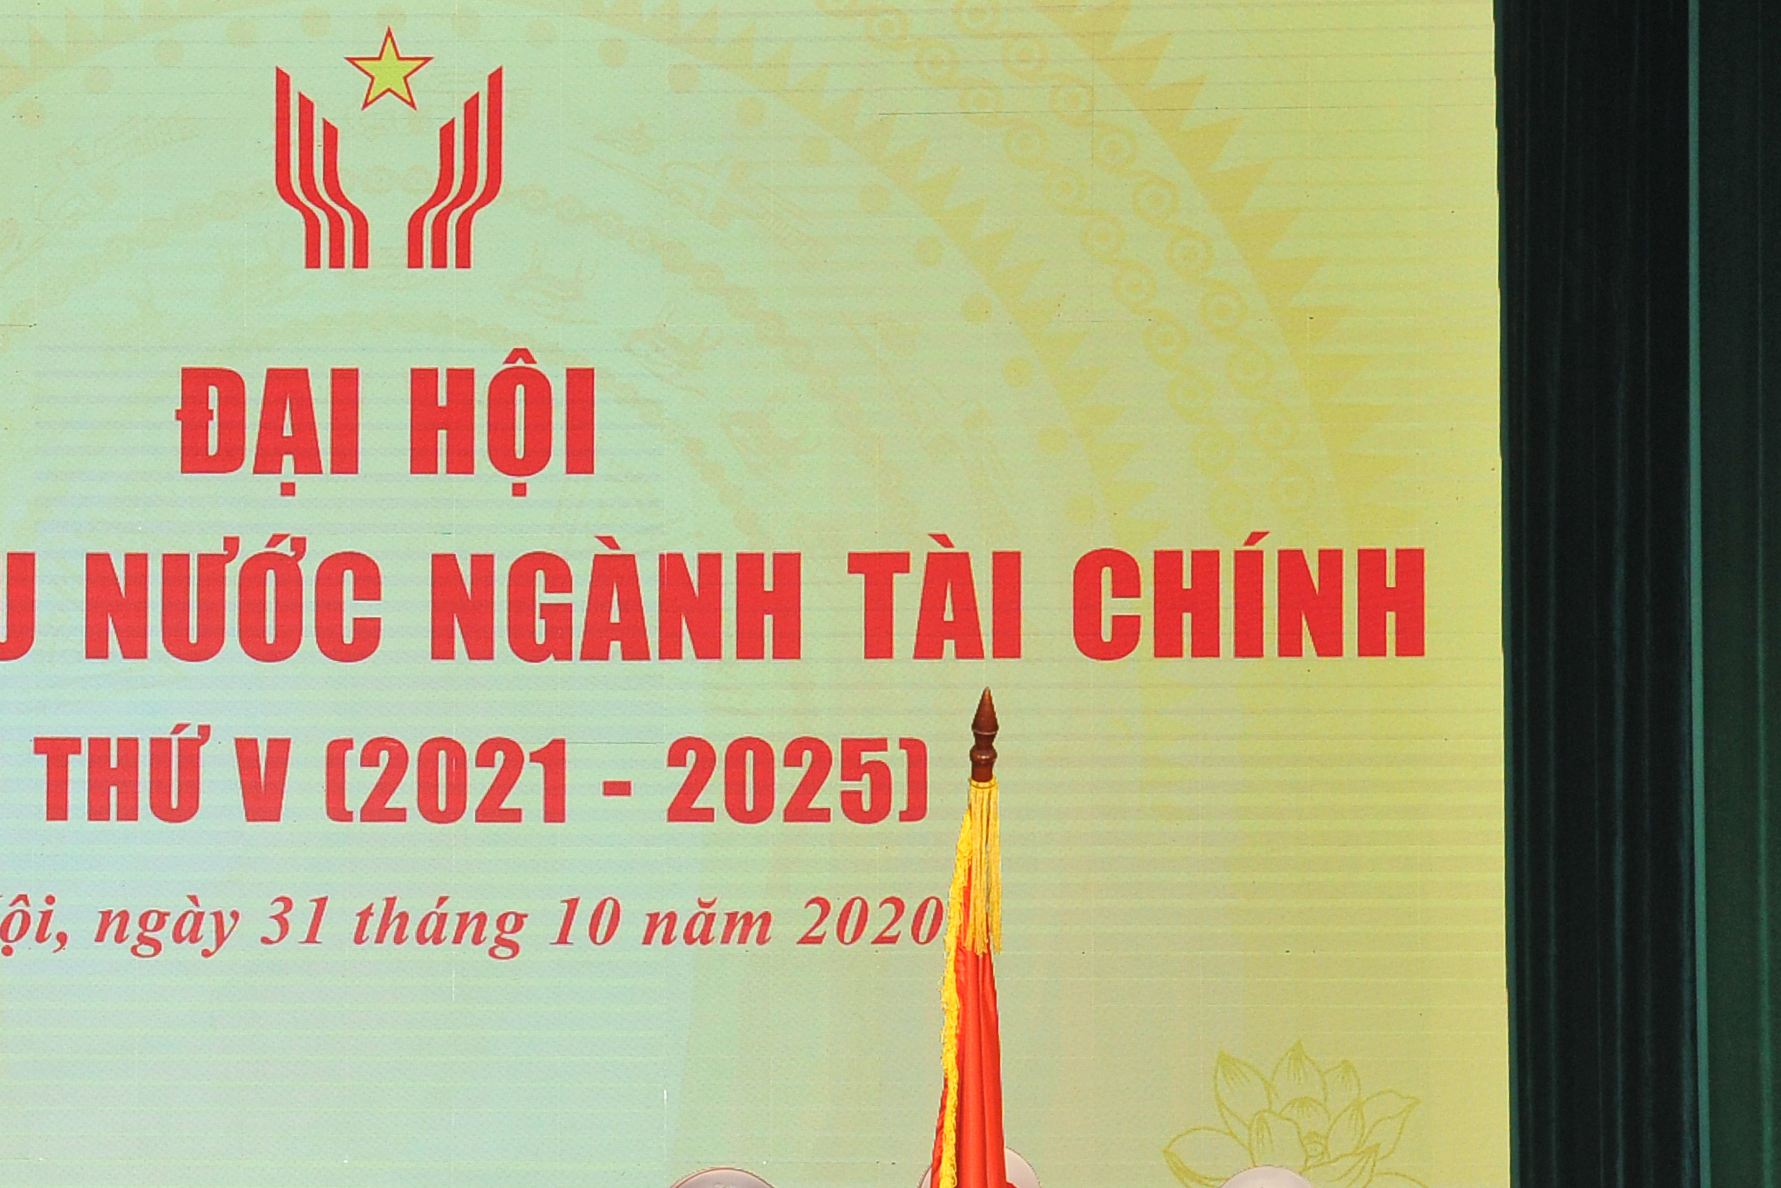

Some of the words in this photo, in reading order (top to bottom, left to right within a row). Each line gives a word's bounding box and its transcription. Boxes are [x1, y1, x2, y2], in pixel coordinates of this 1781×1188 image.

[175, 367, 359, 497] ĐẠI
[410, 347, 596, 497] HỘI
[85, 533, 382, 663] NƯỚC
[431, 535, 802, 664] NGÀNH
[847, 532, 1023, 660] TÀI
[1072, 530, 1426, 662] CHÍNH
[34, 723, 211, 824] THỨ
[235, 737, 292, 823] V
[325, 736, 567, 825] (2021
[603, 780, 632, 797] -
[667, 736, 929, 825] 2025)
[94, 895, 240, 960] ngày
[261, 896, 328, 945] 31
[353, 895, 529, 960] tháng
[549, 896, 622, 946] 10
[643, 898, 773, 947] năm
[796, 895, 945, 947] 2020
